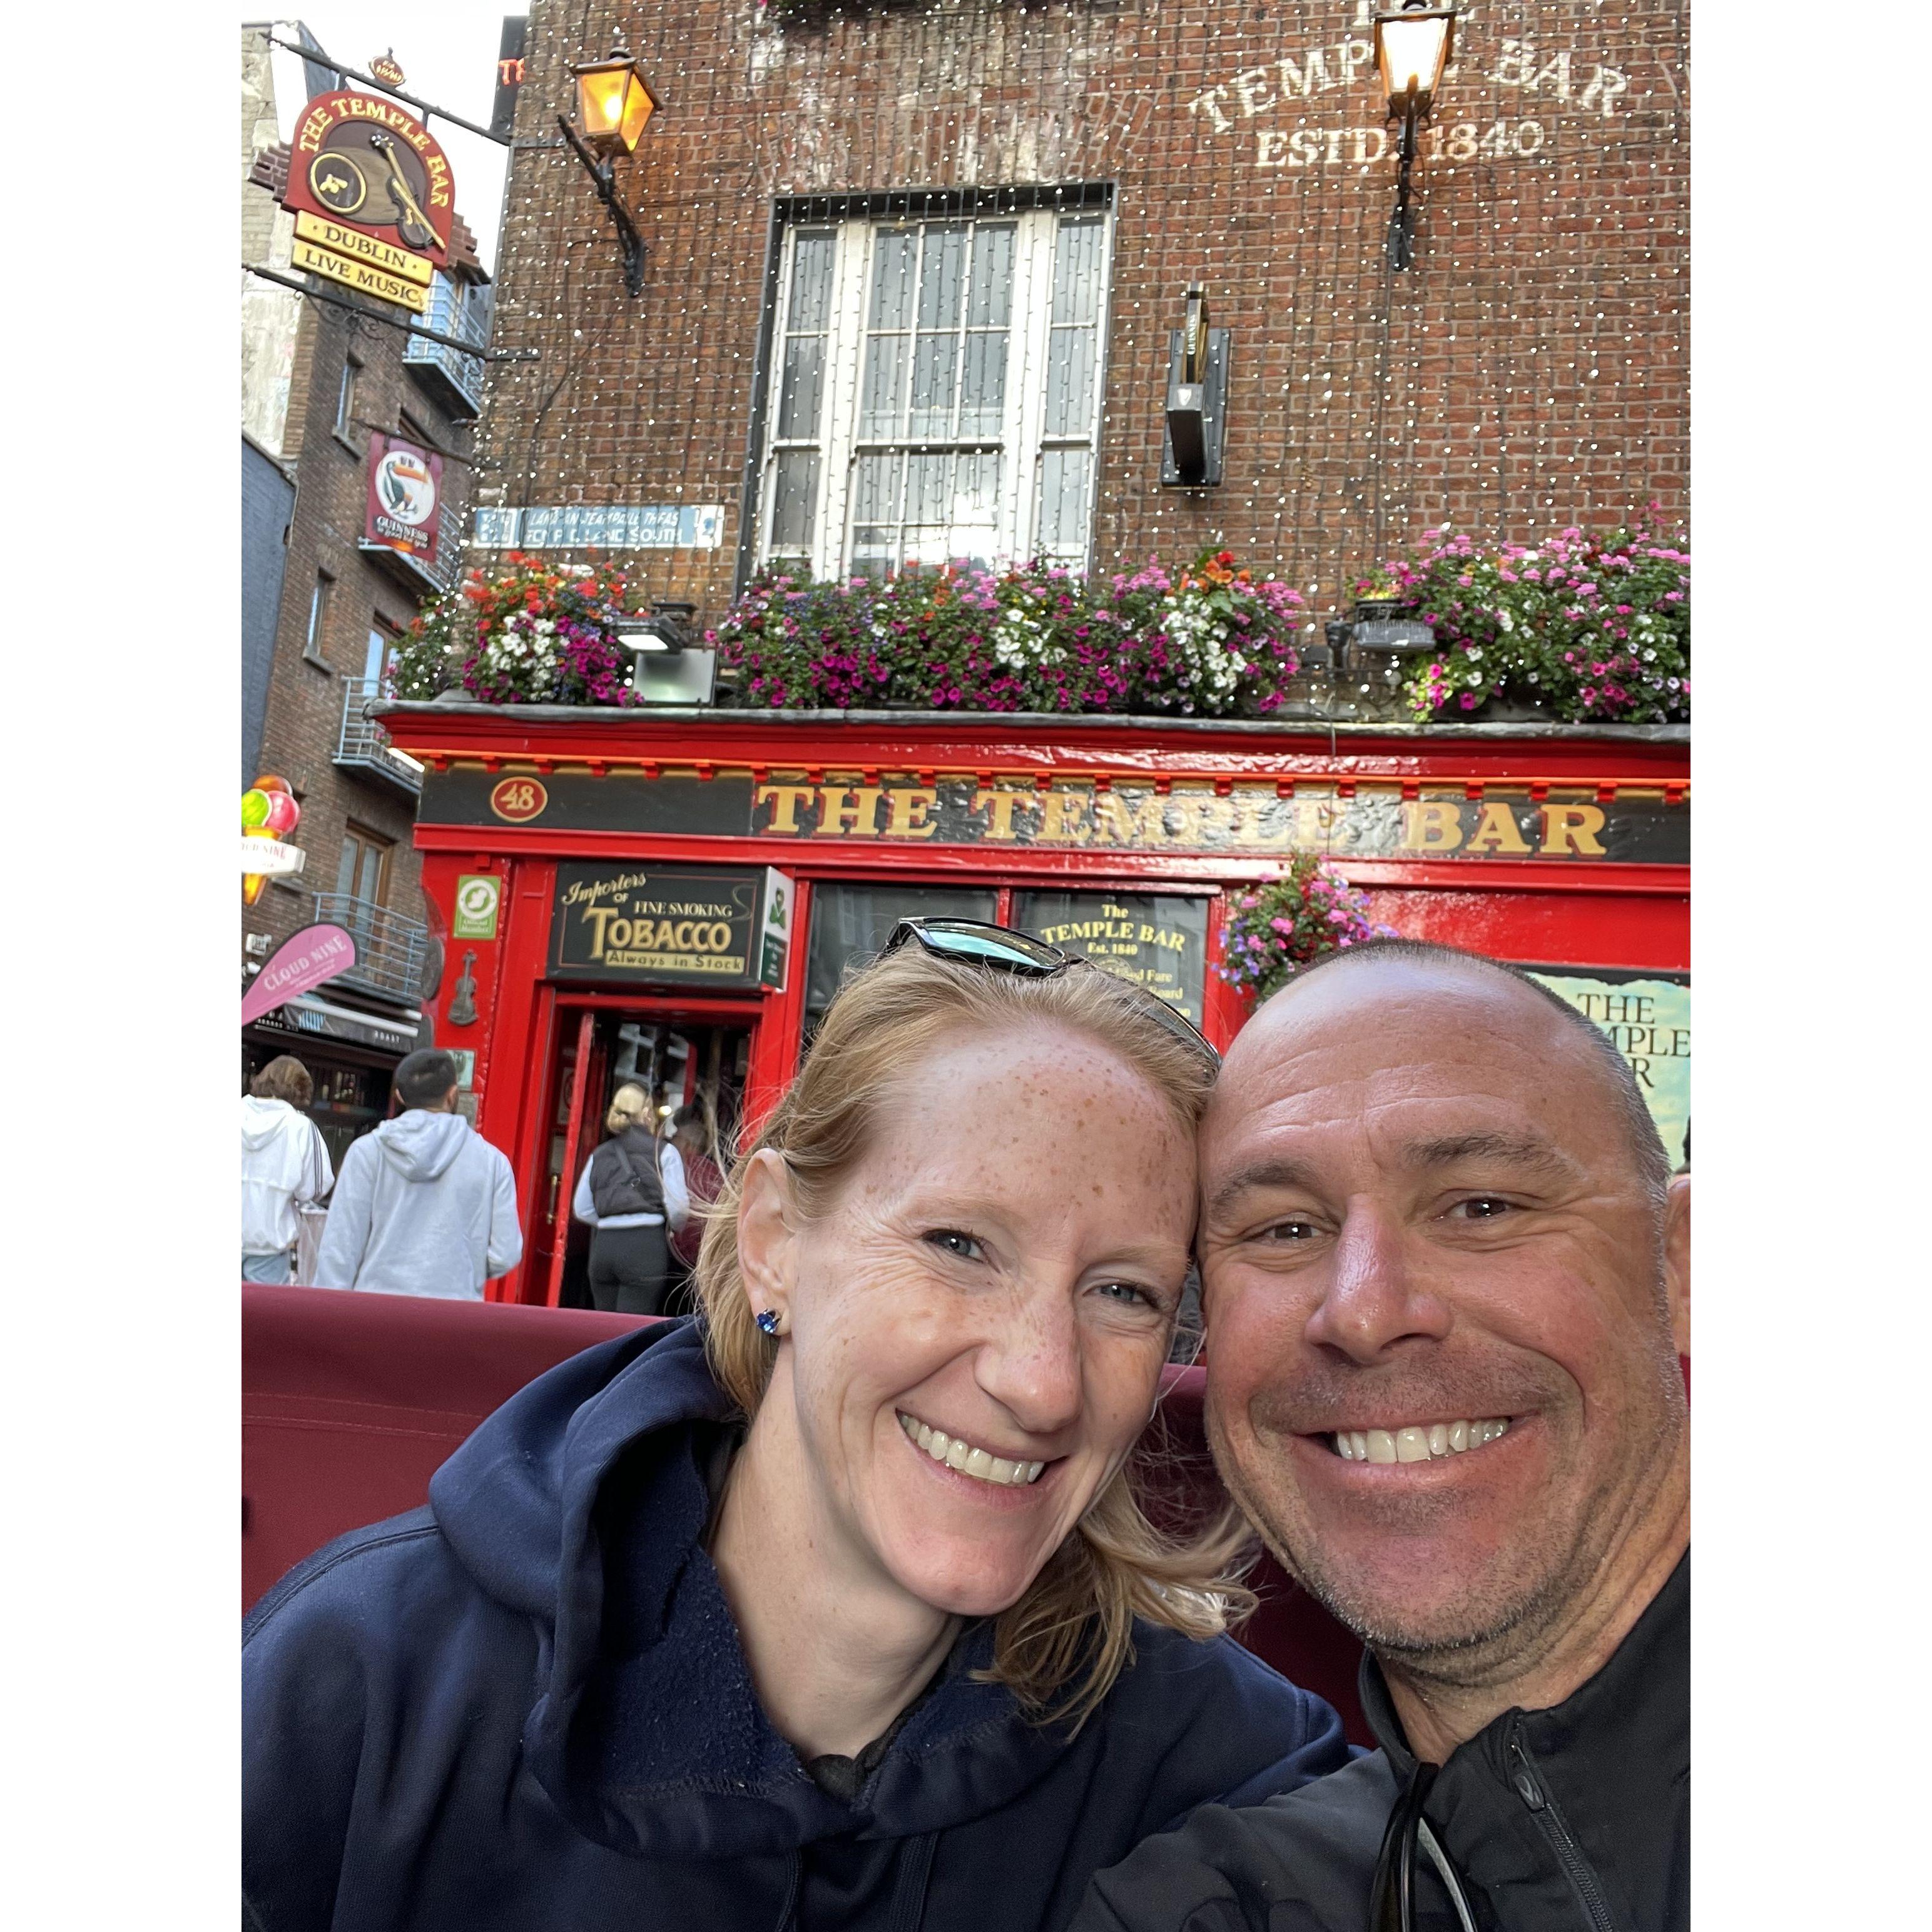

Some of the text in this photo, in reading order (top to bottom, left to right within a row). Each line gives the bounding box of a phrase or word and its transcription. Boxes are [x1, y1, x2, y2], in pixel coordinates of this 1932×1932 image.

[1187, 34, 1627, 133] TEMP BAR
[299, 97, 449, 207] THE TEMPLE BAR
[1426, 121, 1545, 161] 1840
[325, 225, 407, 269] DUBLIN
[304, 250, 419, 302] LIVE MUSIC
[377, 516, 429, 542] GUINNESS
[629, 528, 683, 542] SOUTH
[500, 782, 535, 811] 48
[757, 786, 1607, 856] THE TEMPLE BAR
[561, 872, 647, 907] Importers
[634, 900, 733, 917] FINE SMOKING
[1101, 903, 1129, 918] The
[581, 907, 732, 960] TOBACCO
[1040, 921, 1186, 952] TEMPLE BAR
[1087, 942, 1109, 955] Est.
[263, 957, 310, 991] CLOUD
[310, 935, 348, 962] NINE
[608, 950, 741, 970] Always in Stock
[1577, 993, 1655, 1024] THE
